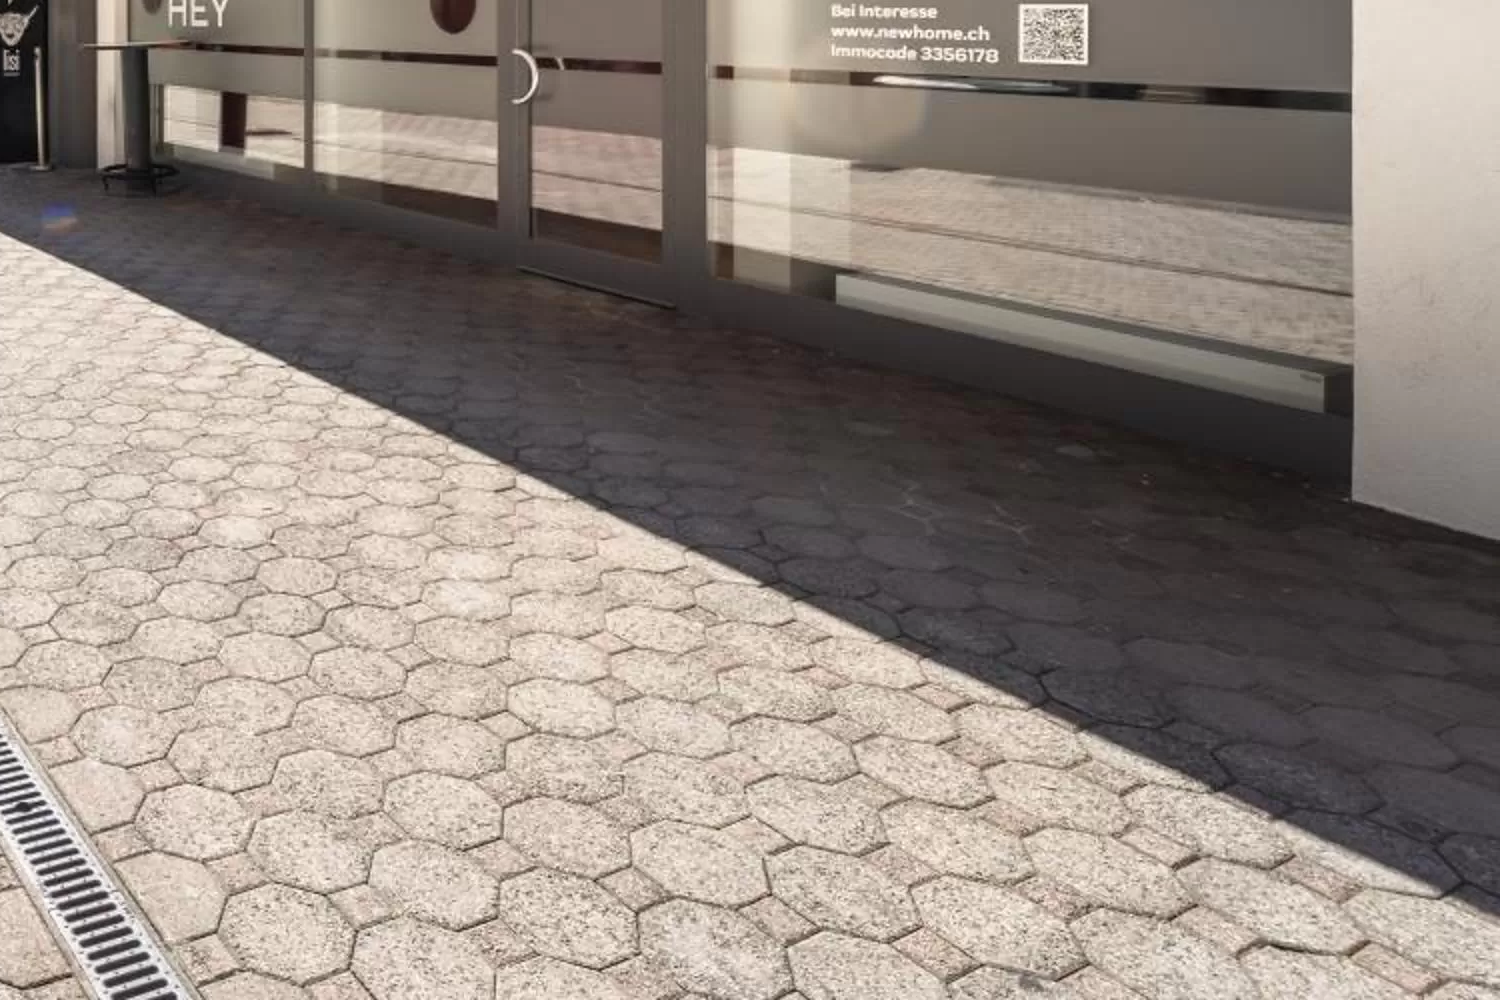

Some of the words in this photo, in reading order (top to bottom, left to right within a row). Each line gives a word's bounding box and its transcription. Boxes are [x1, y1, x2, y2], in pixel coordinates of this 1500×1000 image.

[830, 3, 856, 17] Bei
[859, 4, 938, 19] Interesse
[830, 24, 990, 41] www.newhome.ch
[831, 44, 917, 60] Immocode
[921, 46, 999, 63] 3356178
